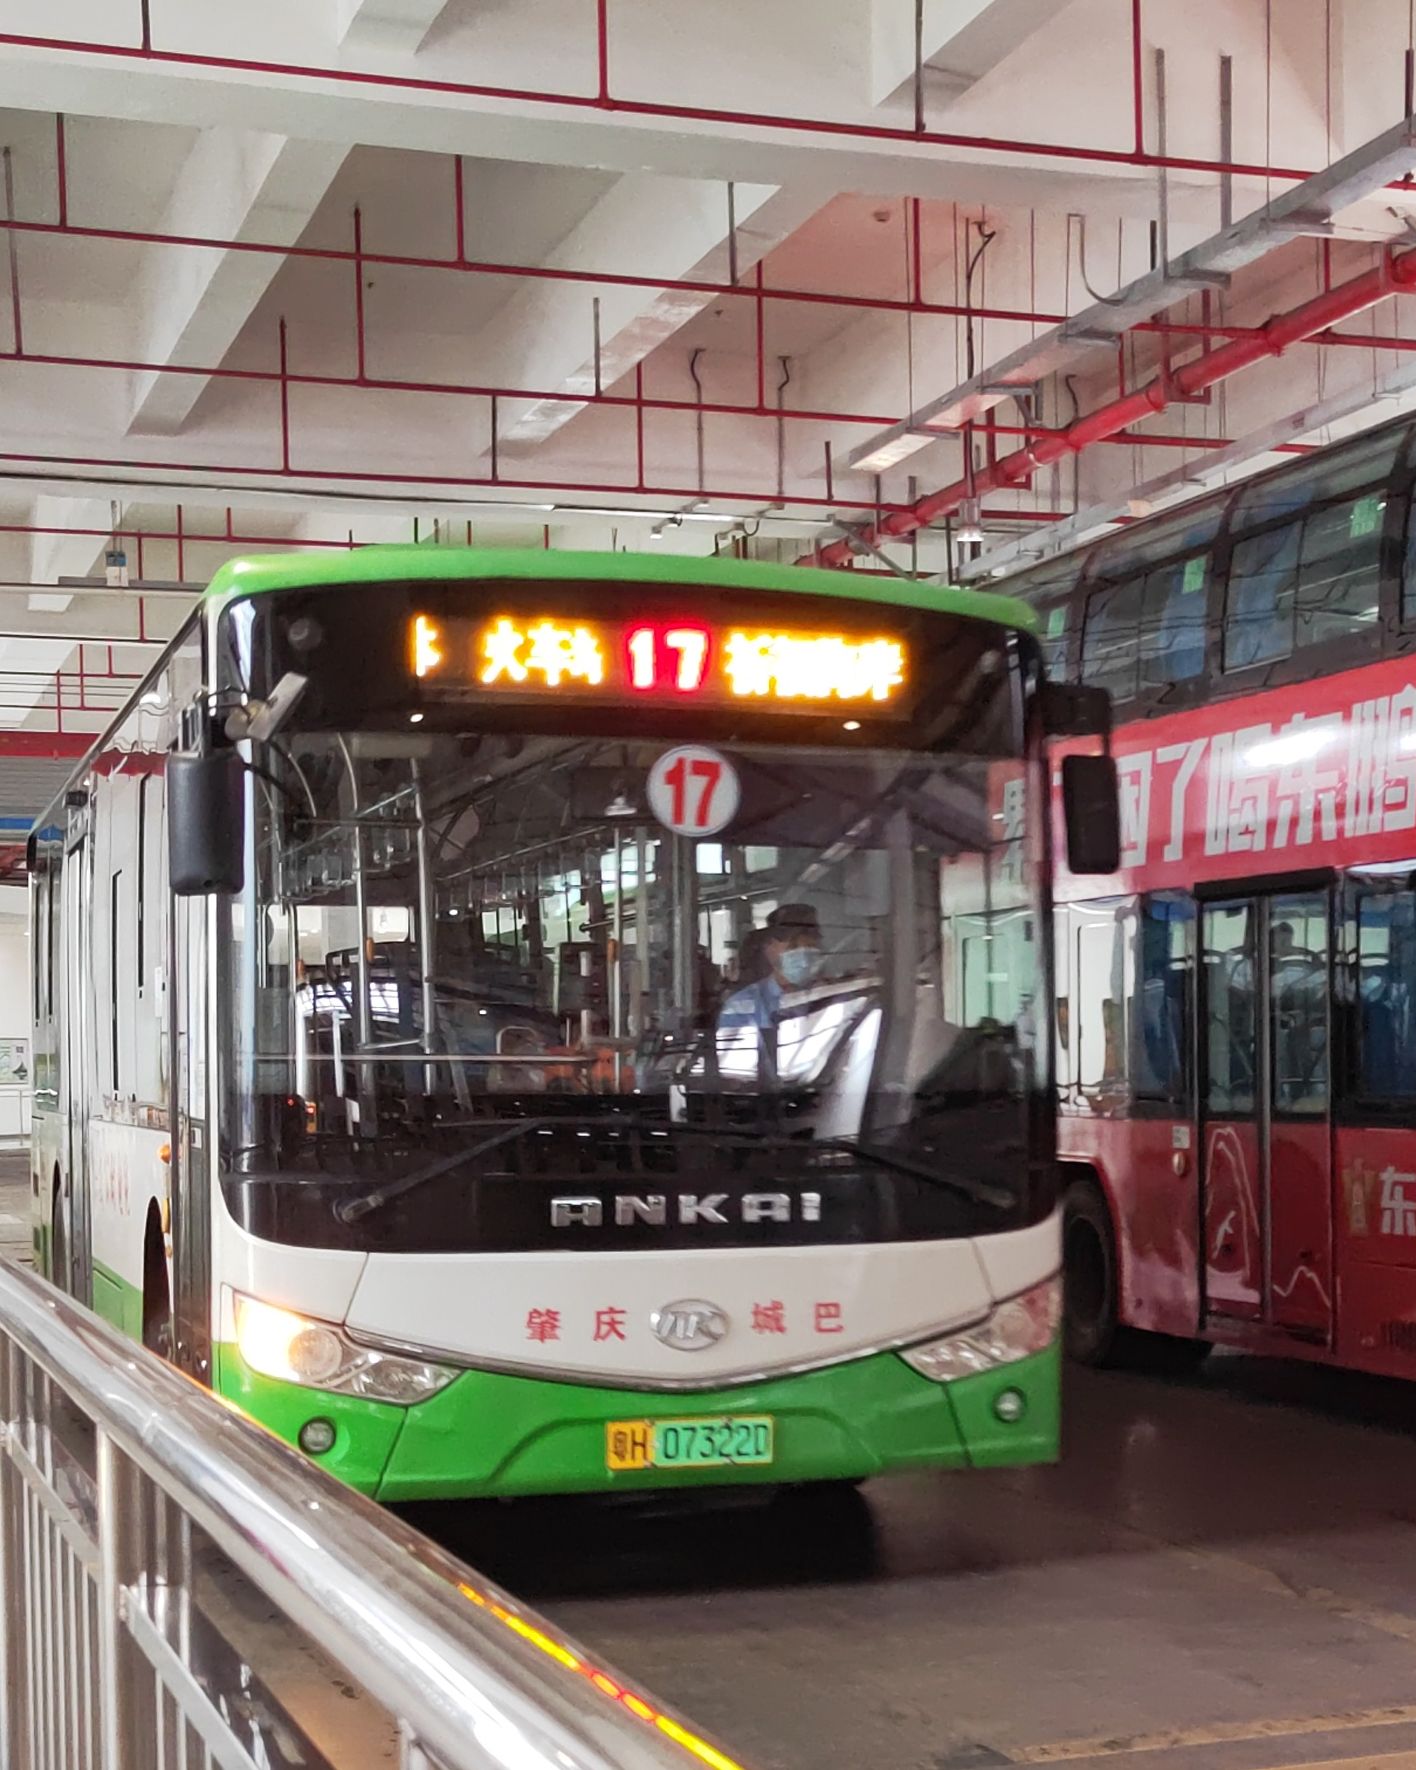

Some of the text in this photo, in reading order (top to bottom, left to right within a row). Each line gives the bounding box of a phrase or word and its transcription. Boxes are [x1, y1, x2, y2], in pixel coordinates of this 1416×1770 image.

[627, 627, 709, 691] 17
[663, 756, 721, 827] 17
[551, 1192, 821, 1228] ANKAI
[526, 1306, 628, 1343] 肇庆
[752, 1300, 845, 1336] 城巴
